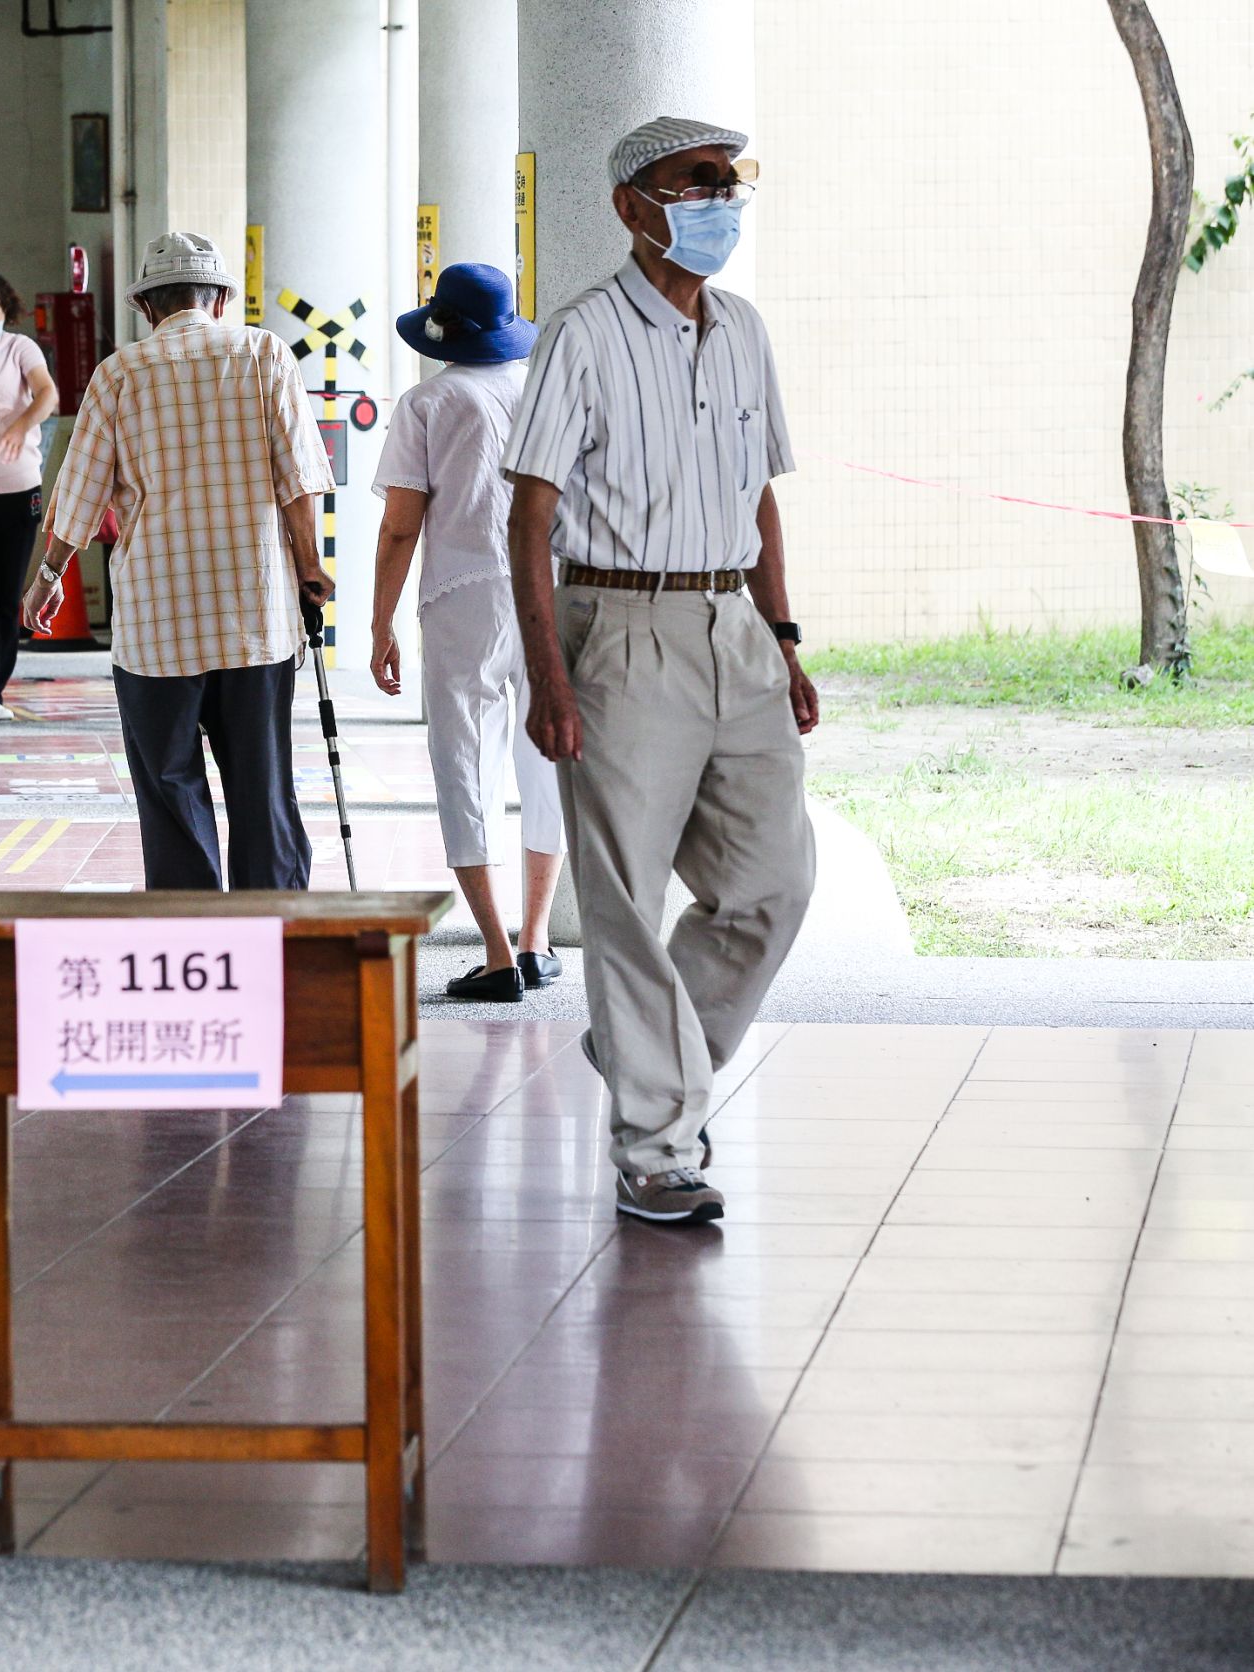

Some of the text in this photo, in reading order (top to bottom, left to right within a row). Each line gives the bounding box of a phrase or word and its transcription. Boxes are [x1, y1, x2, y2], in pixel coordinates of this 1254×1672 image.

[58, 951, 240, 999] 第 1161
[58, 1018, 244, 1064] 投開票所
